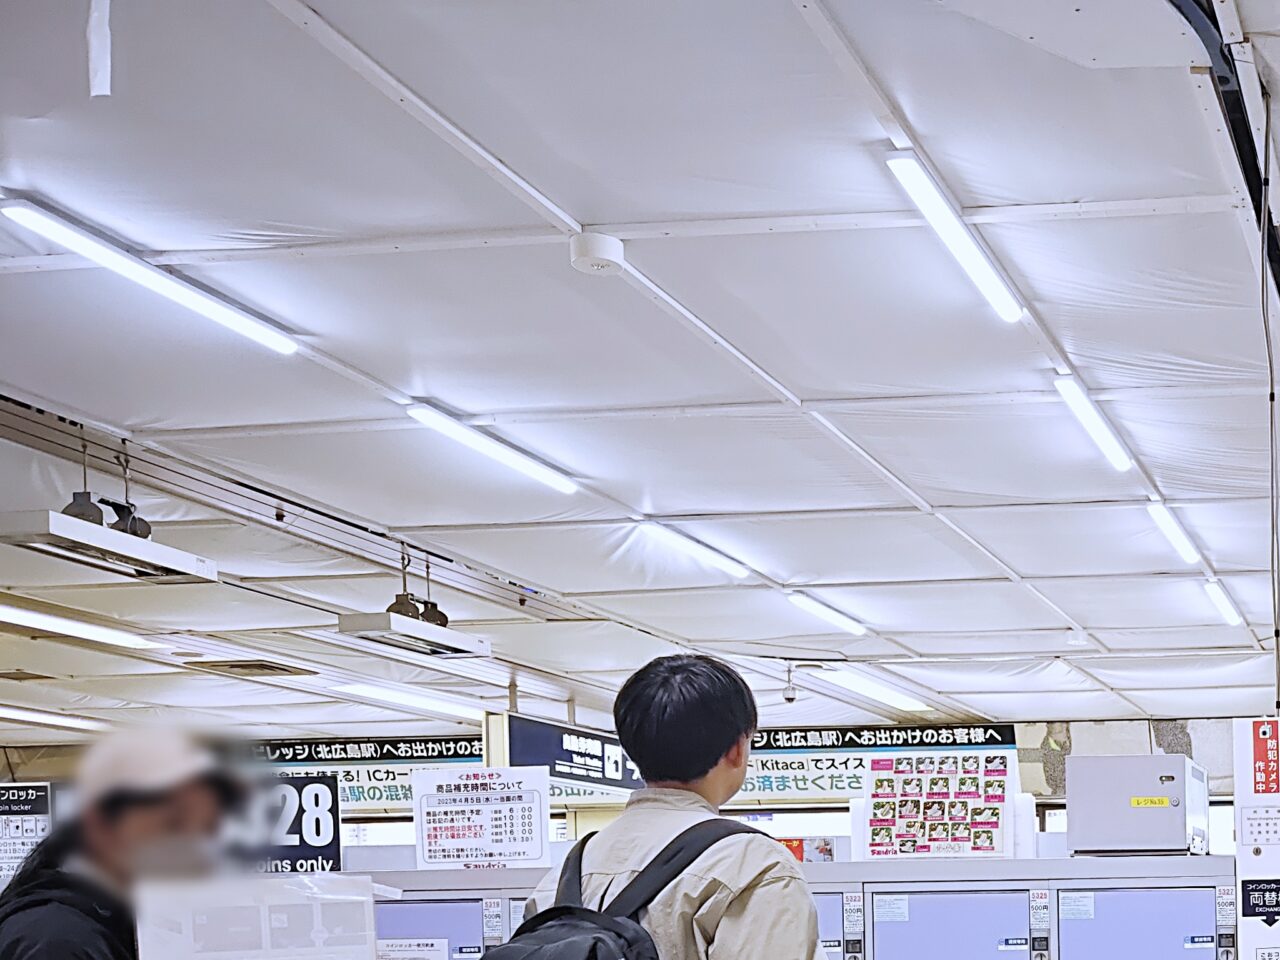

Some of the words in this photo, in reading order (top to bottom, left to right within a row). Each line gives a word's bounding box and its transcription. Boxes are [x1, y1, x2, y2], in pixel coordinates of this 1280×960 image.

[753, 728, 1002, 748] ジ（北広島駅）へお出かけのお客様へ
[1266, 739, 1278, 793] 防犯カメラ
[1255, 760, 1266, 793] 作動中
[436, 780, 524, 794] 商品補充時間について
[11, 803, 32, 812] locker
[296, 855, 333, 873] only
